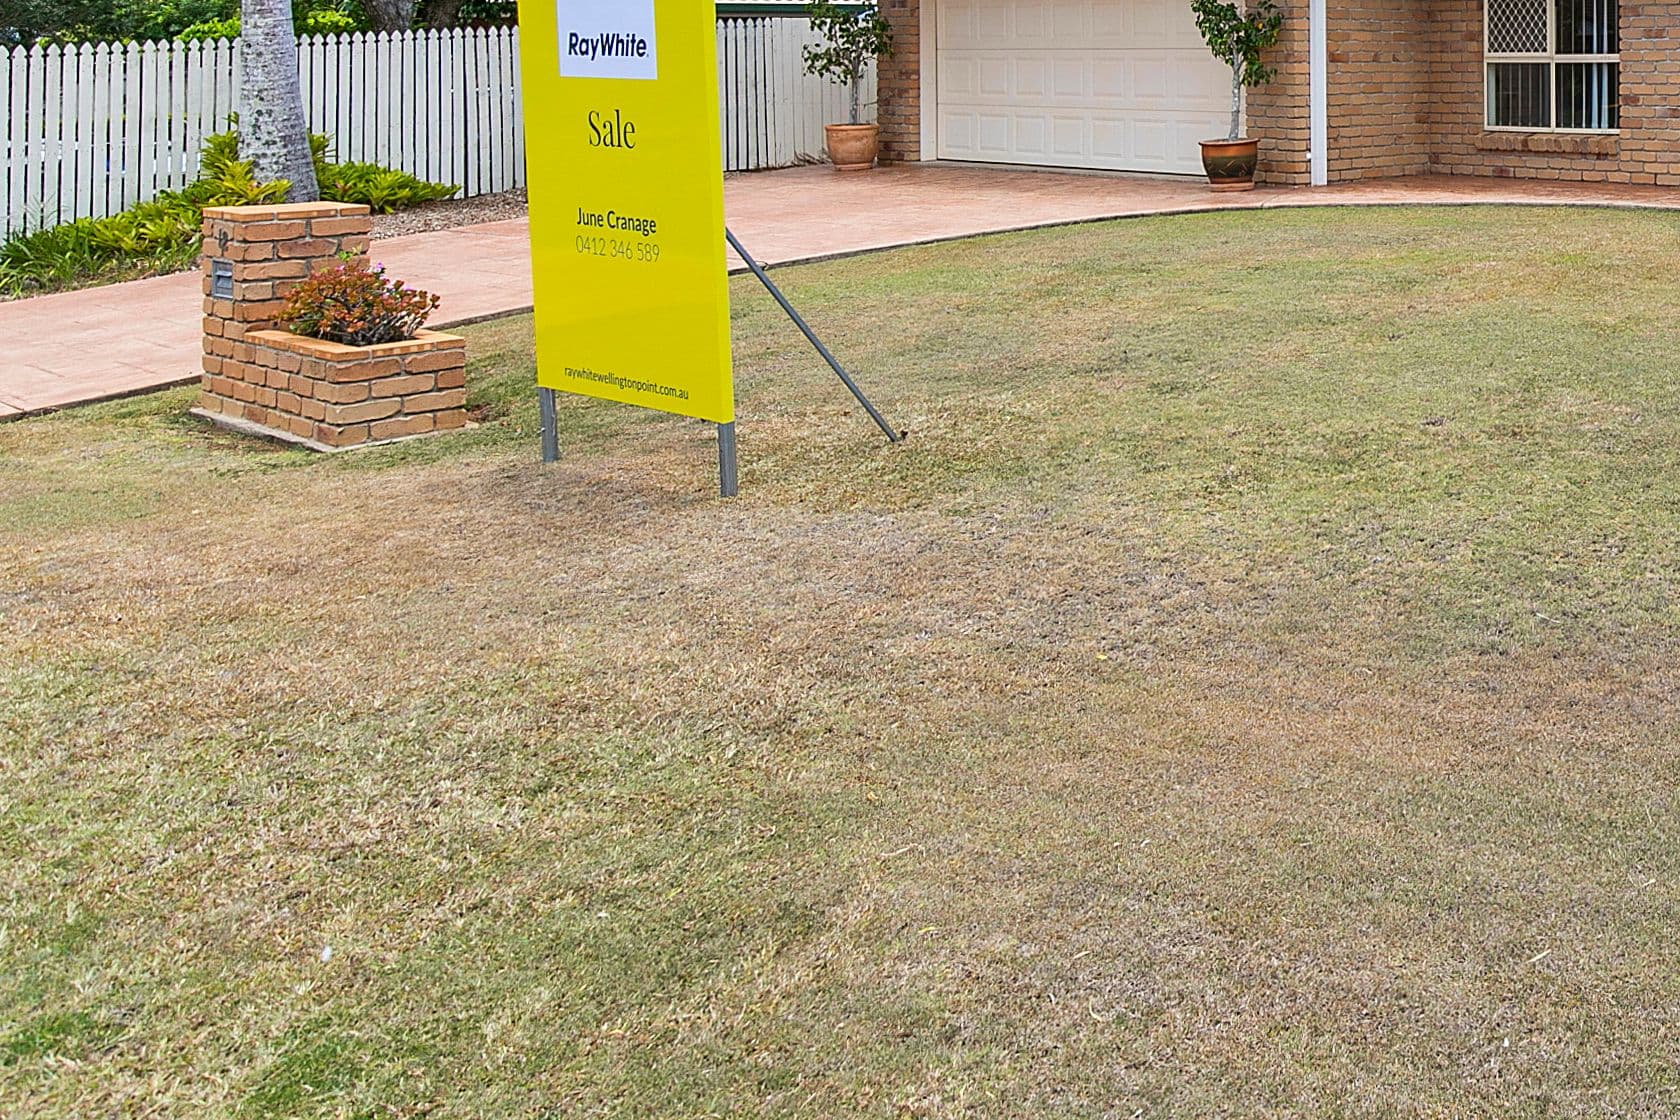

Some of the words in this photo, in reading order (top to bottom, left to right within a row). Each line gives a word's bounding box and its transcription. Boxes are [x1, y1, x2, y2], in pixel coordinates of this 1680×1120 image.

[588, 109, 636, 149] Sale
[576, 207, 604, 228] June
[607, 210, 657, 237] Cranage
[575, 235, 606, 256] 0412
[609, 239, 633, 260] 346
[637, 242, 660, 262] 589
[564, 366, 689, 400] raywhitewellingtonpoint.com.au
